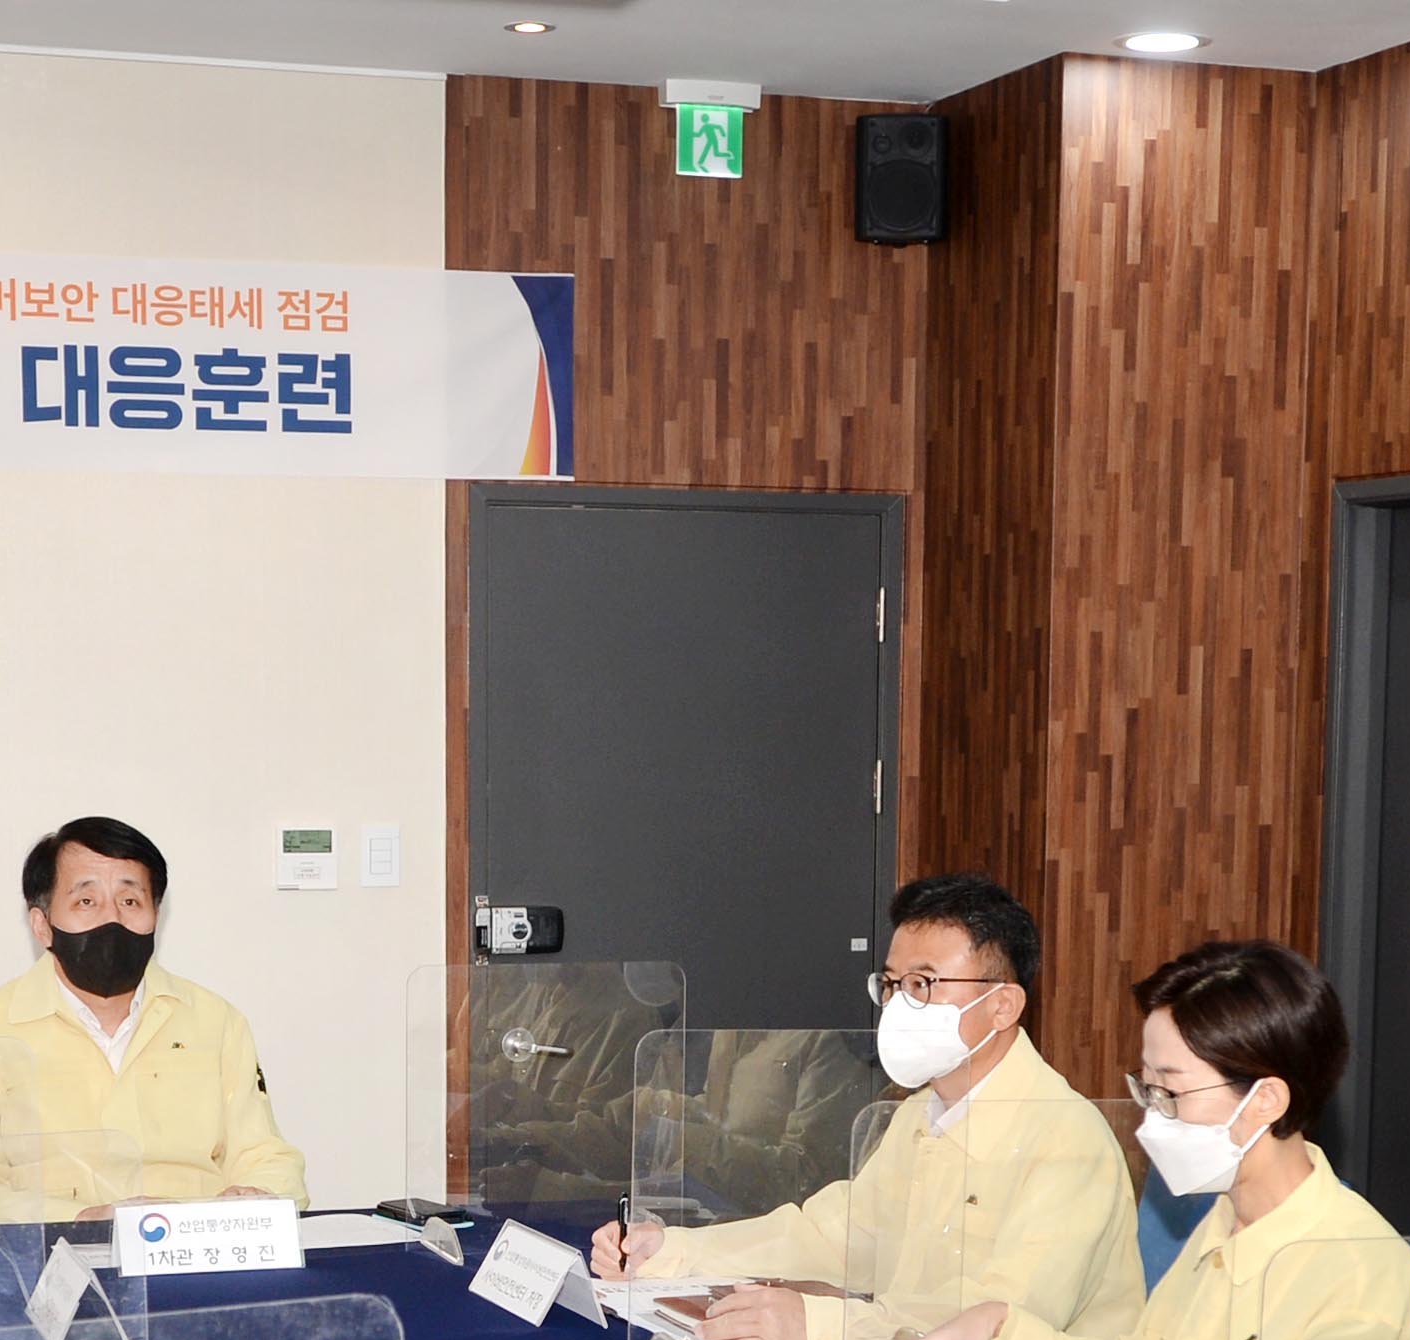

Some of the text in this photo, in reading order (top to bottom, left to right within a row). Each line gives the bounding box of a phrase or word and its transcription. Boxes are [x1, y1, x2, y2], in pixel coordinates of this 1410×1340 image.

[112, 283, 264, 330] 대응태세
[278, 290, 349, 333] 점검
[23, 345, 352, 433] 대응훈련
[177, 1217, 274, 1234] 산업통상자원부
[147, 1248, 194, 1267] 1차관
